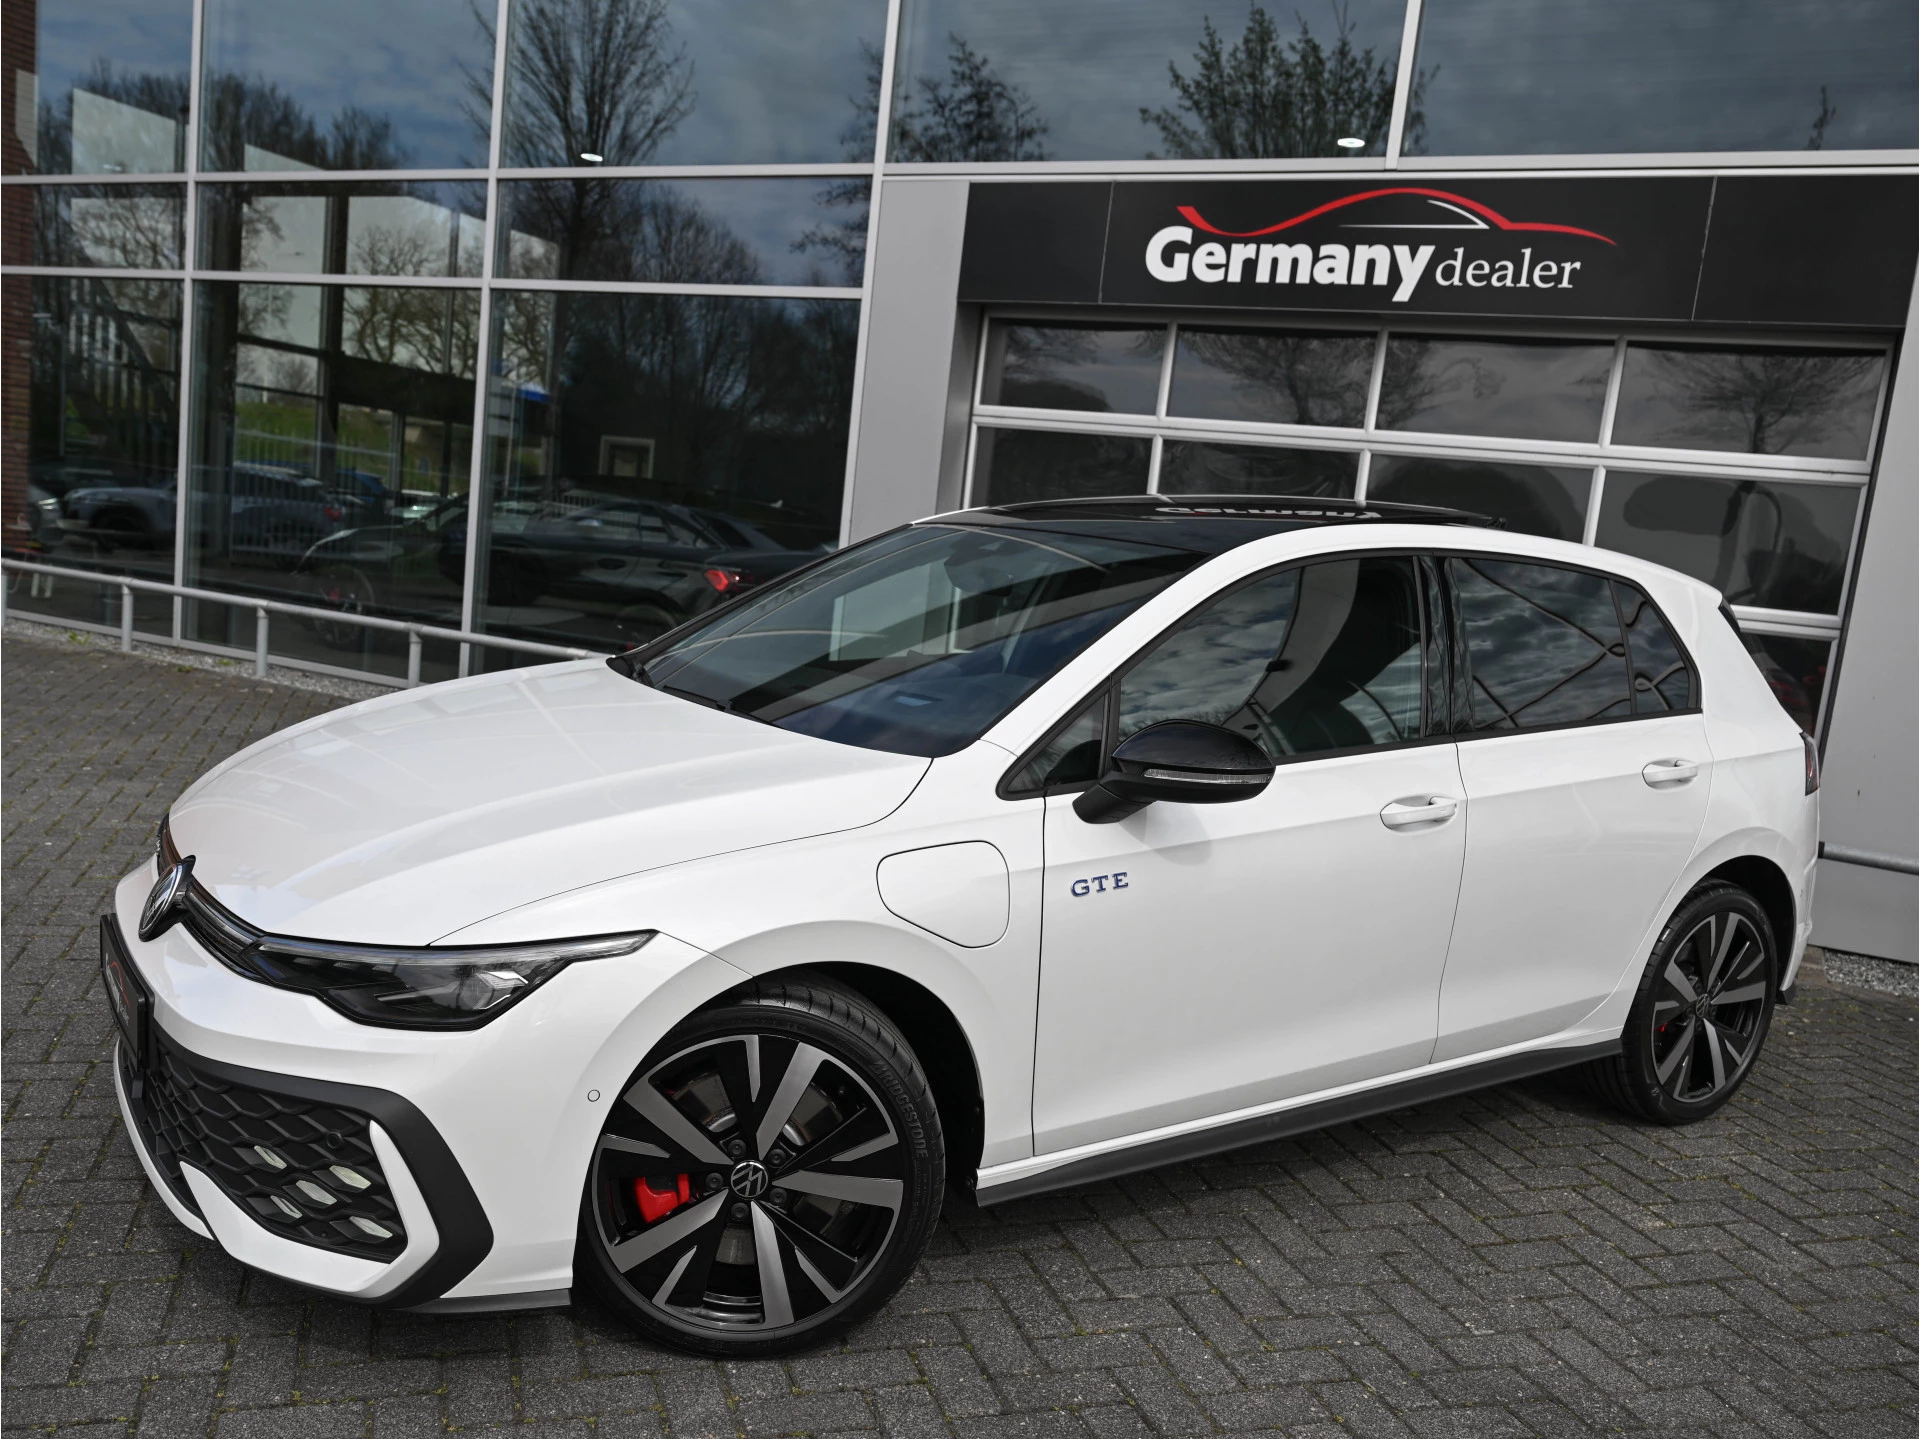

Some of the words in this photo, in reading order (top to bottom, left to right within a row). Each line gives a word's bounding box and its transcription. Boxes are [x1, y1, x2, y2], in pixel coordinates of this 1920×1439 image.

[1145, 225, 1436, 303] Germany
[1435, 248, 1581, 289] dealer
[1071, 872, 1129, 897] GTE
[870, 1061, 929, 1158] BRIDGESTONE
